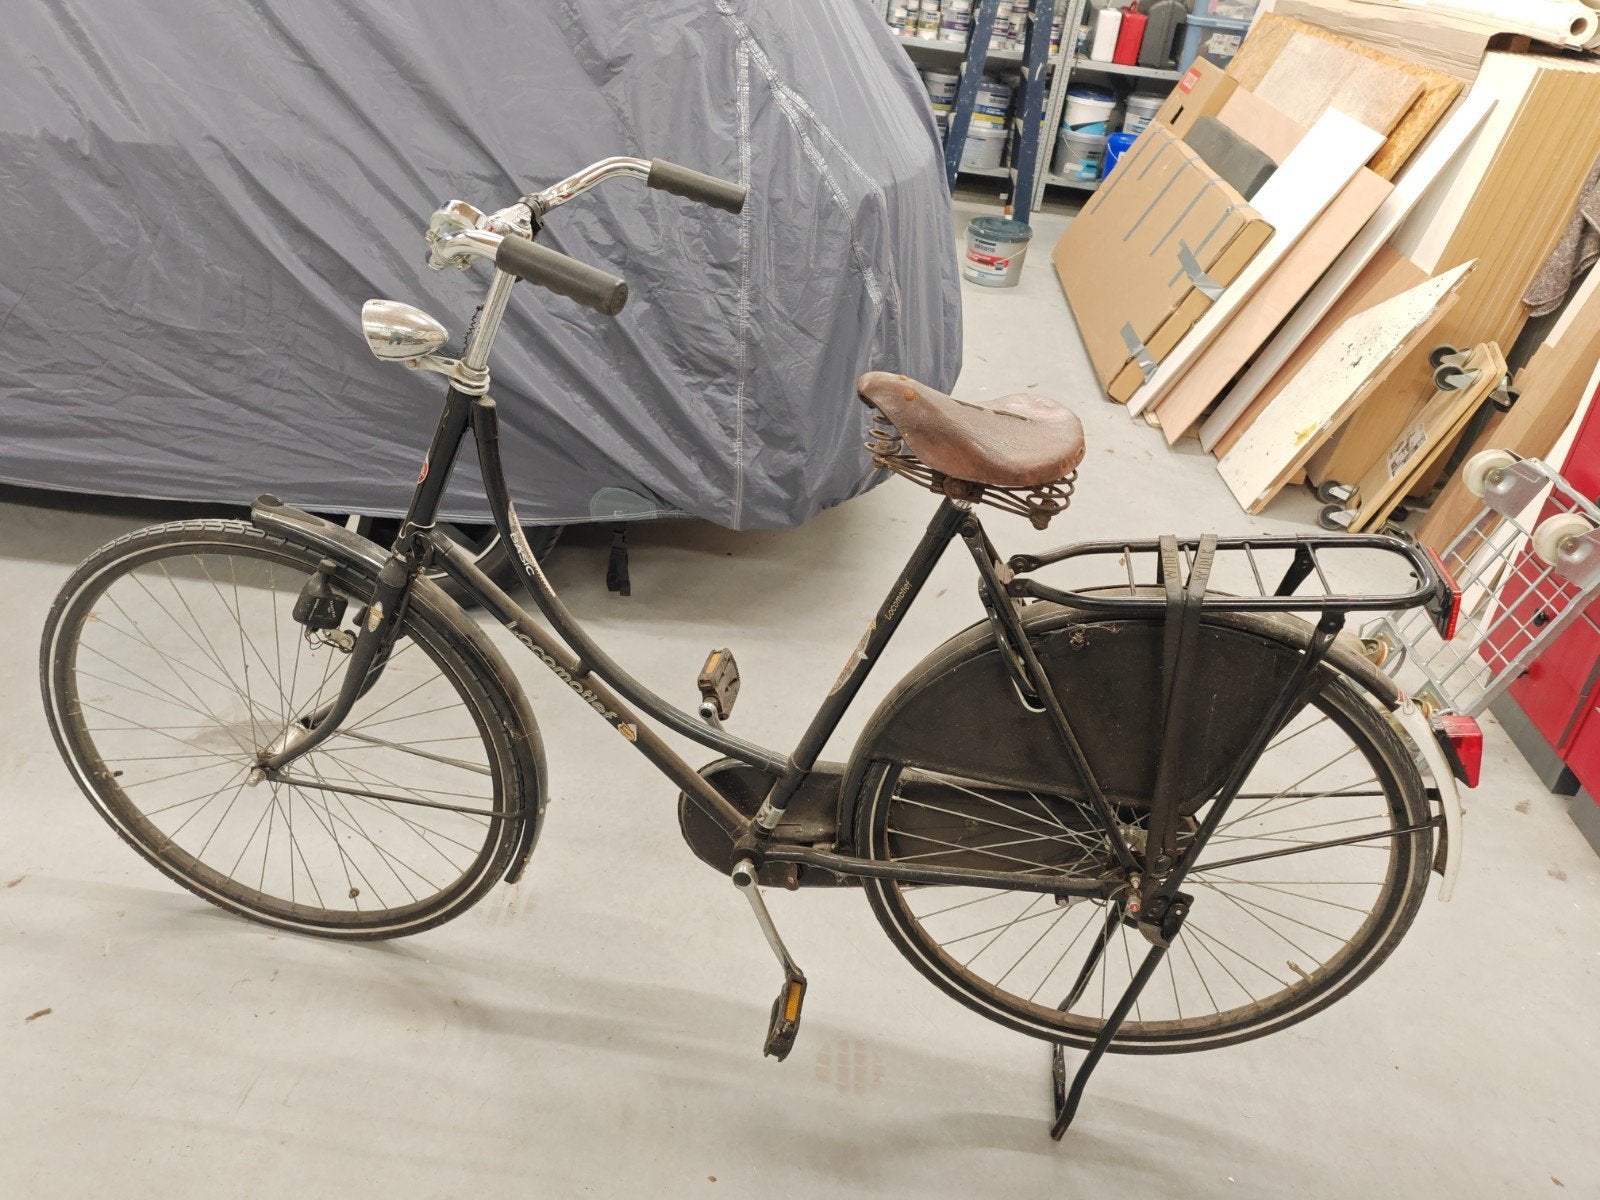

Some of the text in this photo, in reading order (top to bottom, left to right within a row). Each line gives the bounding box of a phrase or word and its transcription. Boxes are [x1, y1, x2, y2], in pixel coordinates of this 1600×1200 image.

[510, 532, 534, 576] BASIC
[884, 578, 913, 621] Locomotief
[504, 620, 618, 720] Locomotief
